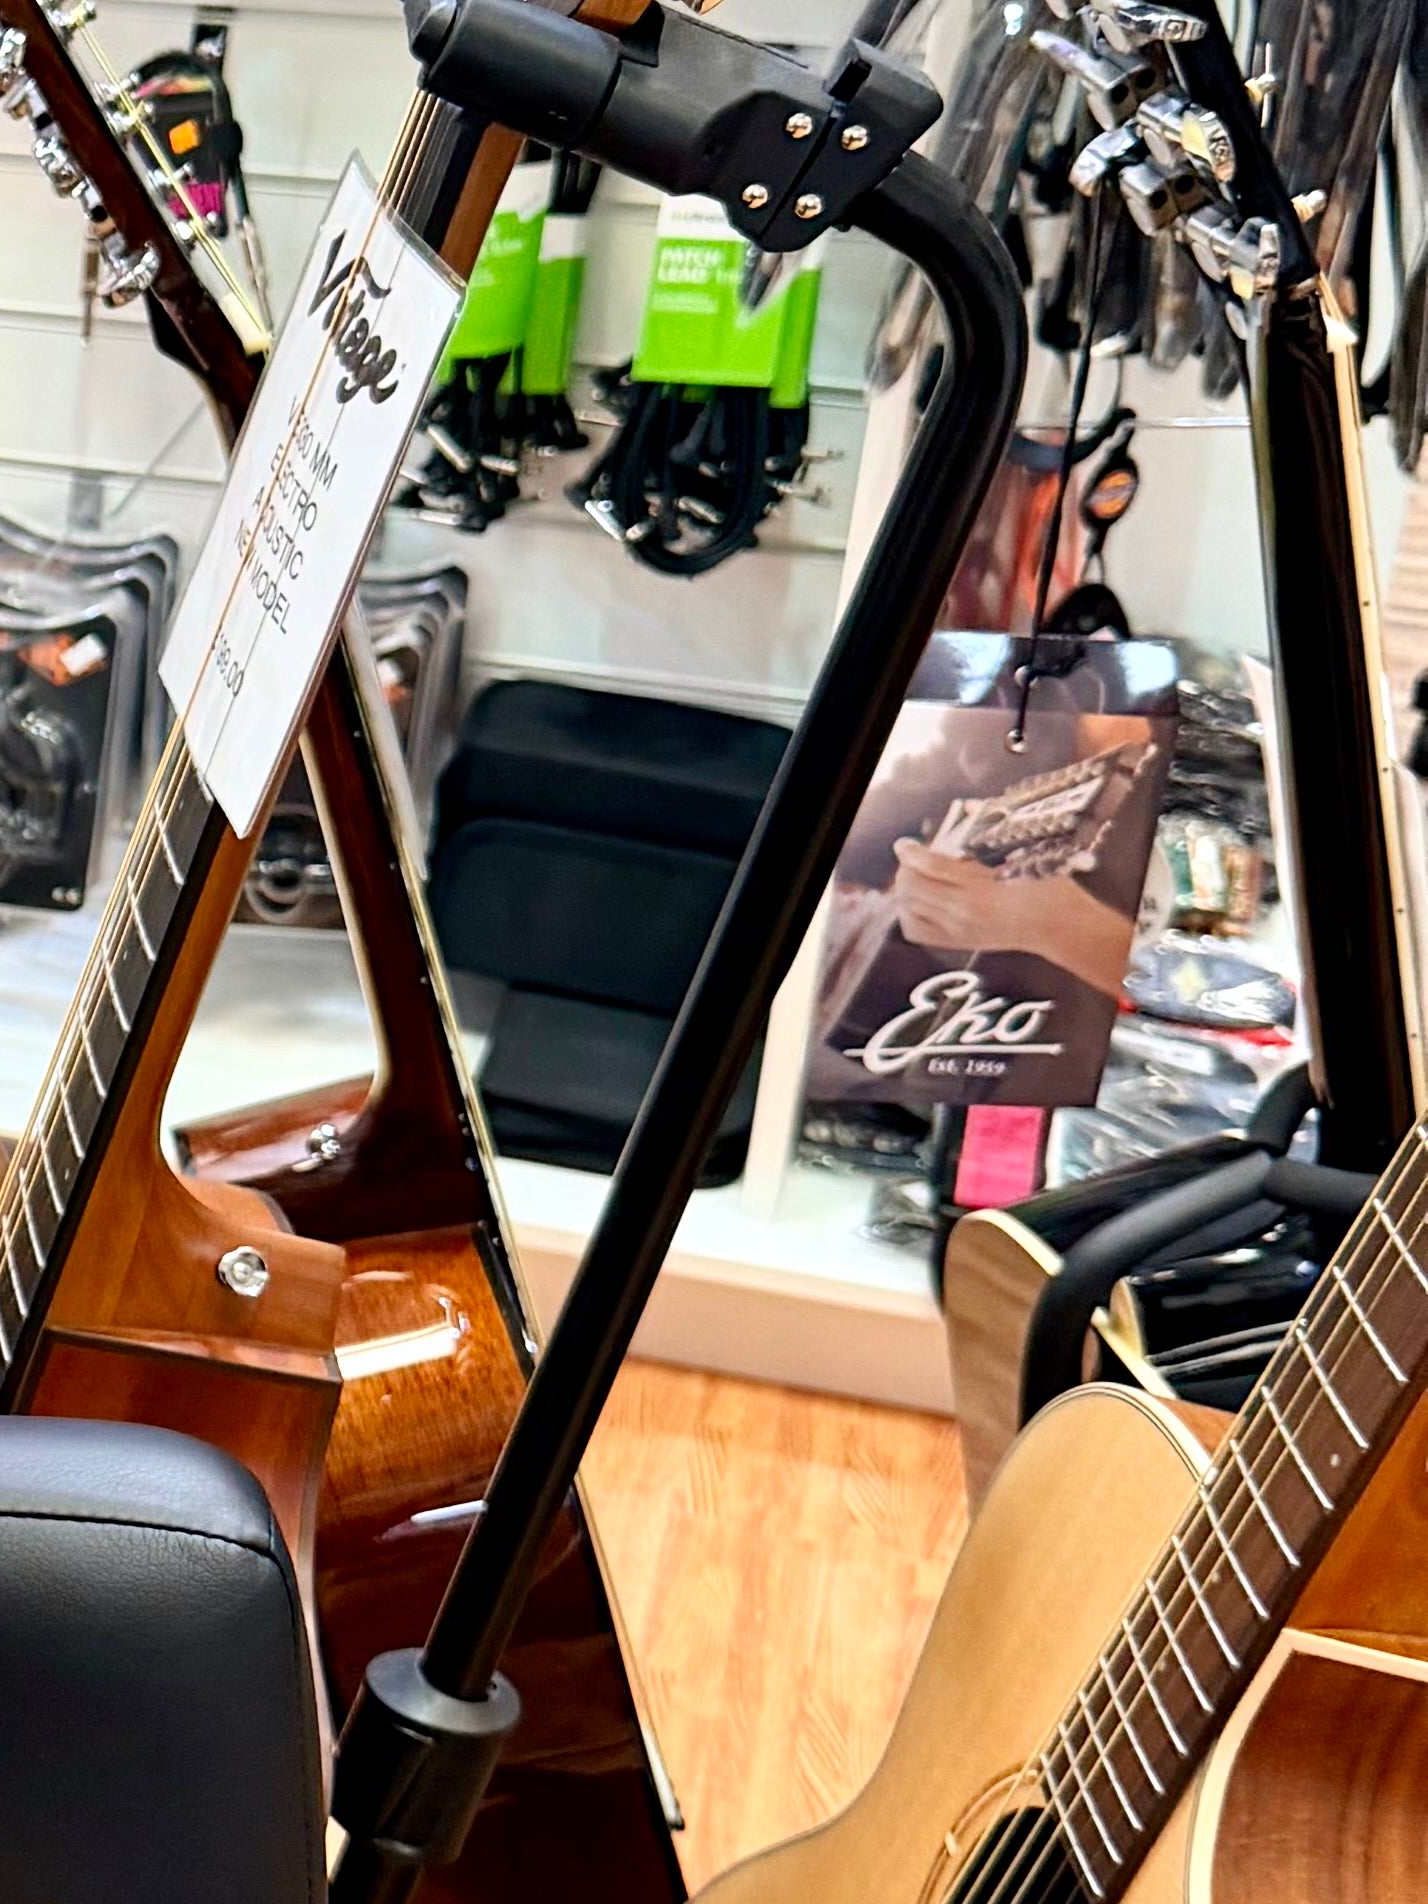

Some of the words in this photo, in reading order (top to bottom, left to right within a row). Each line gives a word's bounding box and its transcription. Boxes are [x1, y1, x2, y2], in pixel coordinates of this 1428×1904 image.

[307, 229, 400, 405] Vintage
[309, 441, 339, 493] MM
[863, 970, 1056, 1076] Eko
